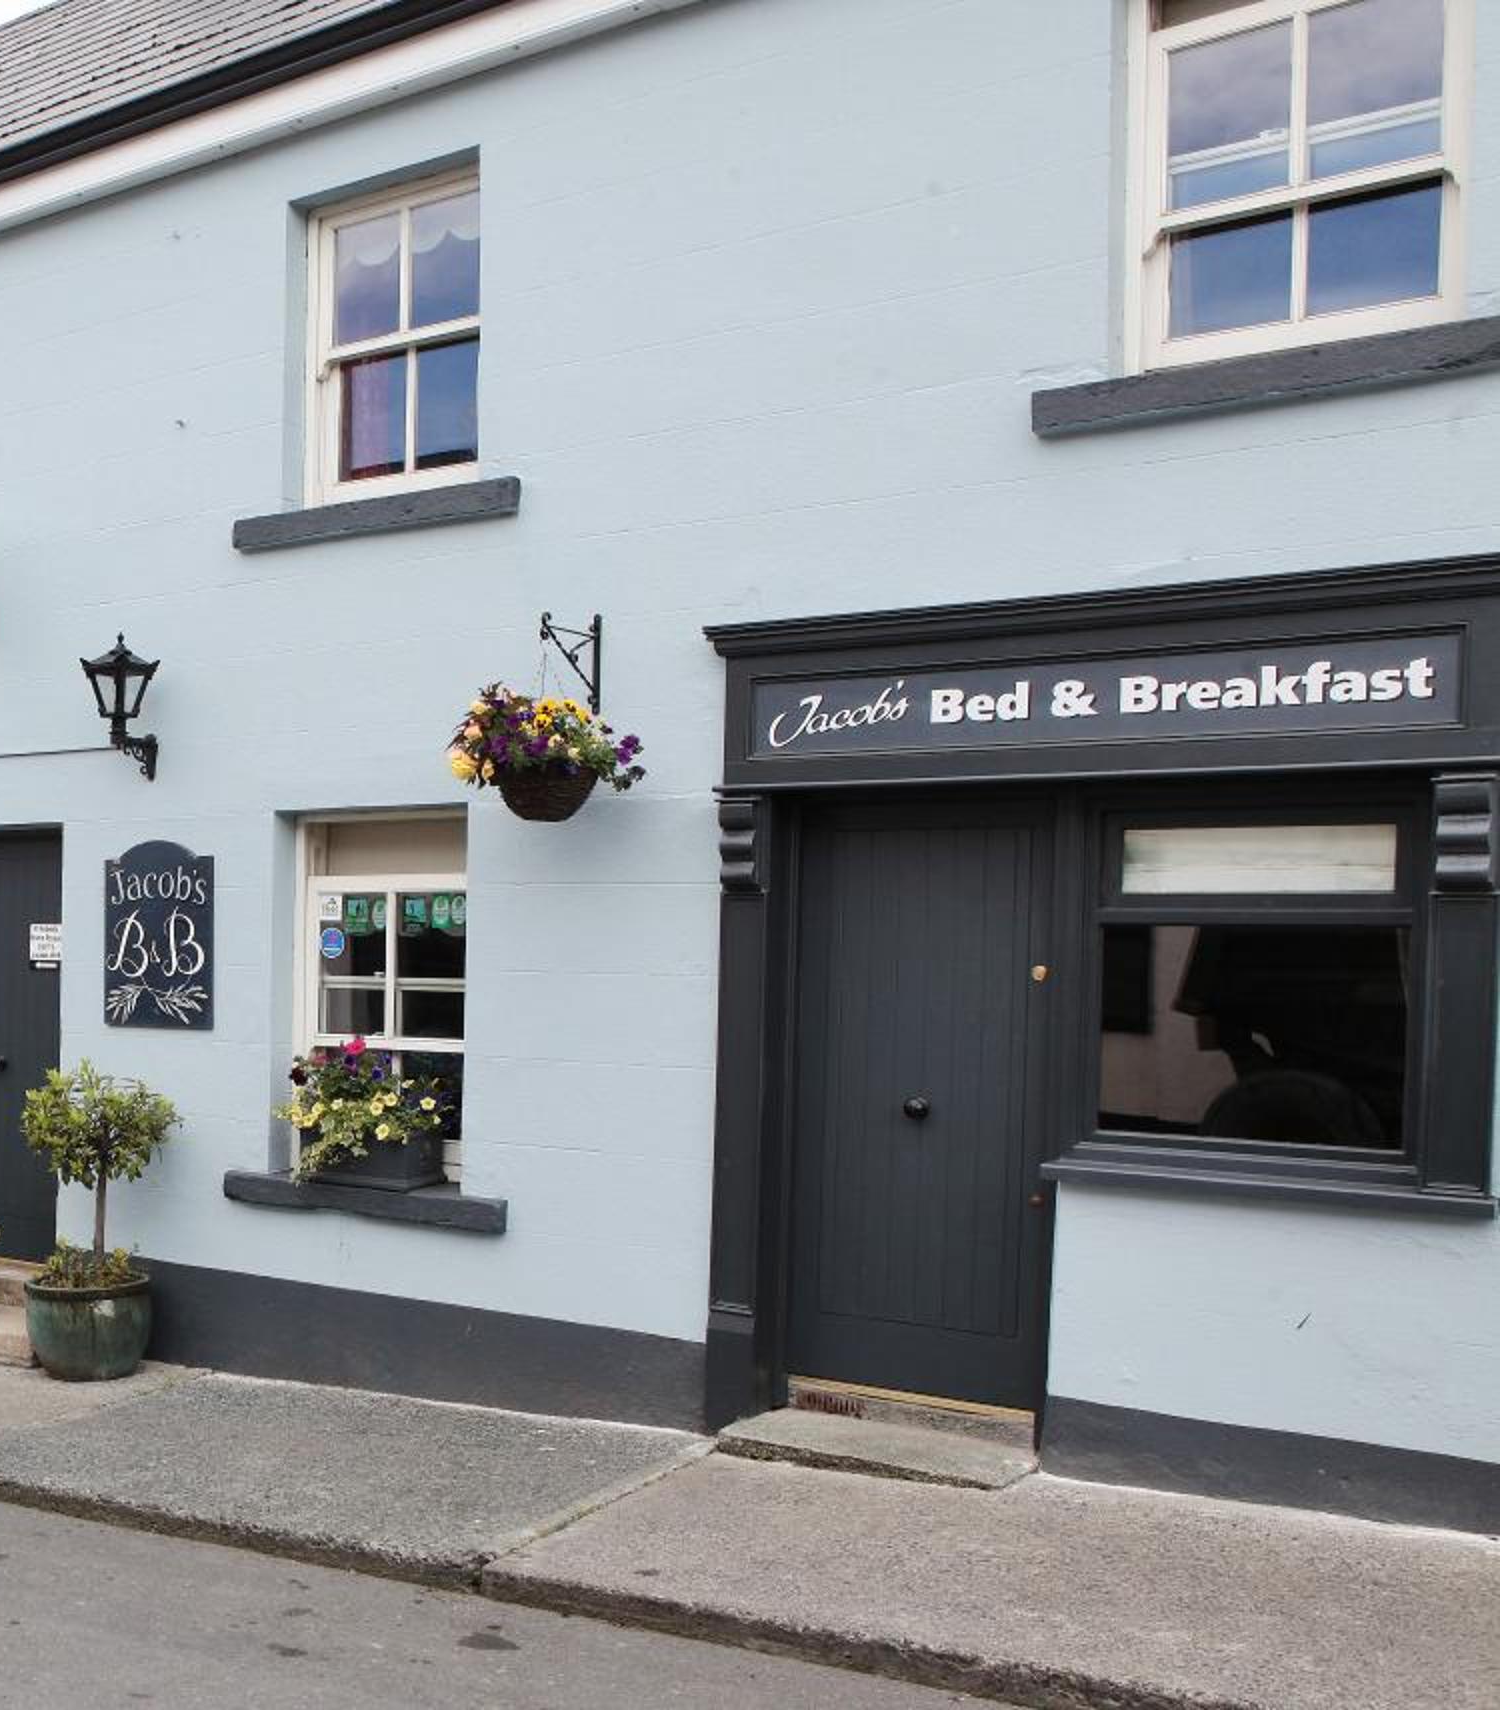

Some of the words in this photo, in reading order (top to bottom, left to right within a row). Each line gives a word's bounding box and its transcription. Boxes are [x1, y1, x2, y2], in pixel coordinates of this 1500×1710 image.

[769, 679, 909, 747] Jacob's
[930, 681, 1030, 723] Bed
[1050, 679, 1099, 718] &
[1119, 656, 1434, 714] Breakfast
[110, 864, 207, 905] Jacob's
